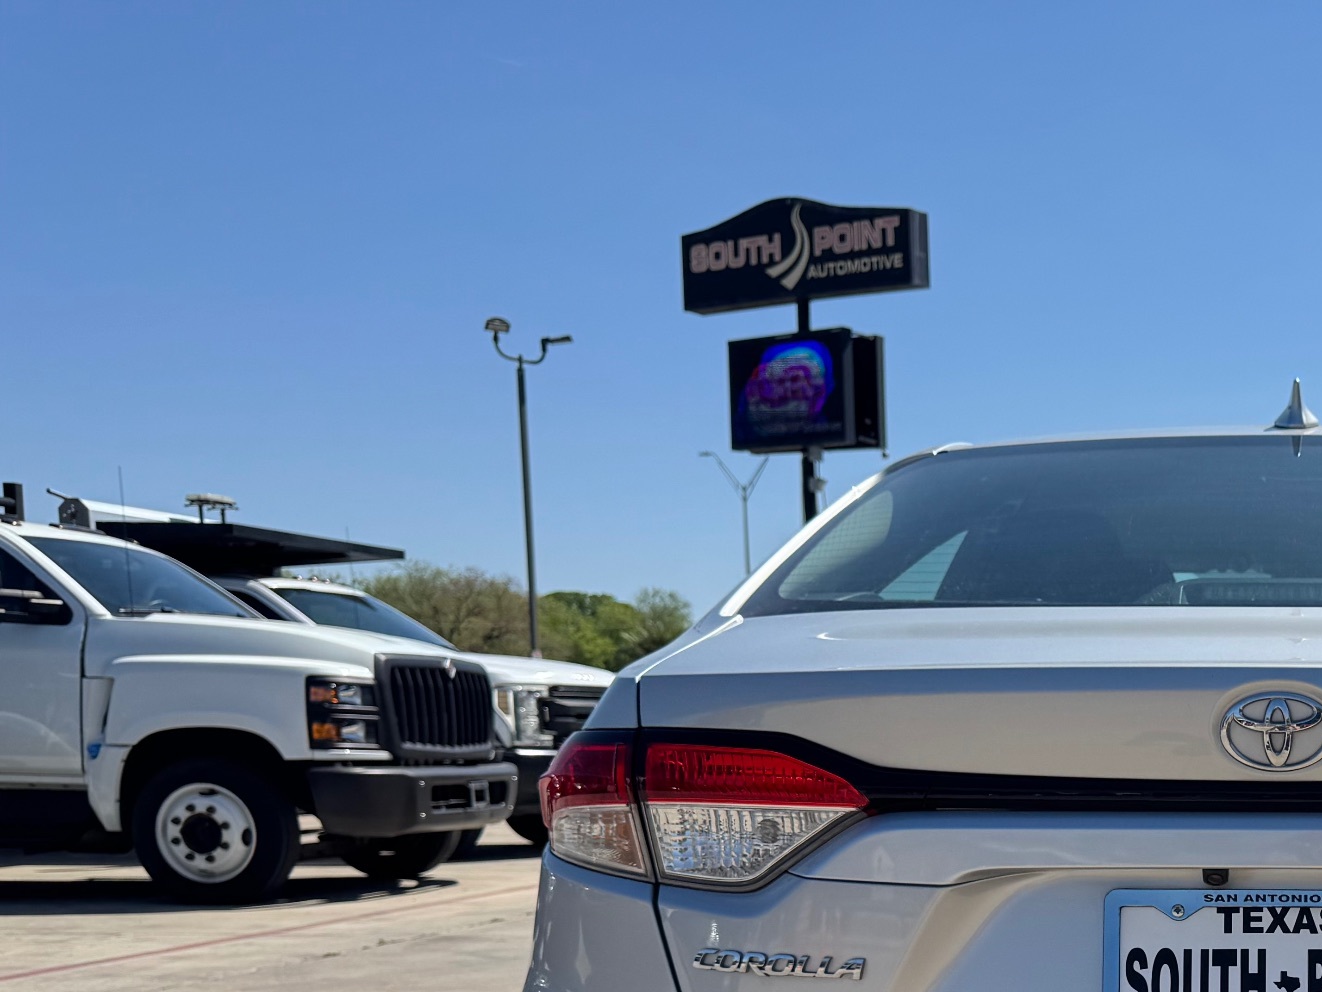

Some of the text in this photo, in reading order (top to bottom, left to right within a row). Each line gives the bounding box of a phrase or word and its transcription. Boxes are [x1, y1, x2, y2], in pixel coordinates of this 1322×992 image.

[690, 215, 900, 274] SOUTH POINT
[807, 252, 904, 280] AUTOMOTIVE
[1203, 893, 1239, 904] SAN
[693, 947, 867, 981] COROLLA
